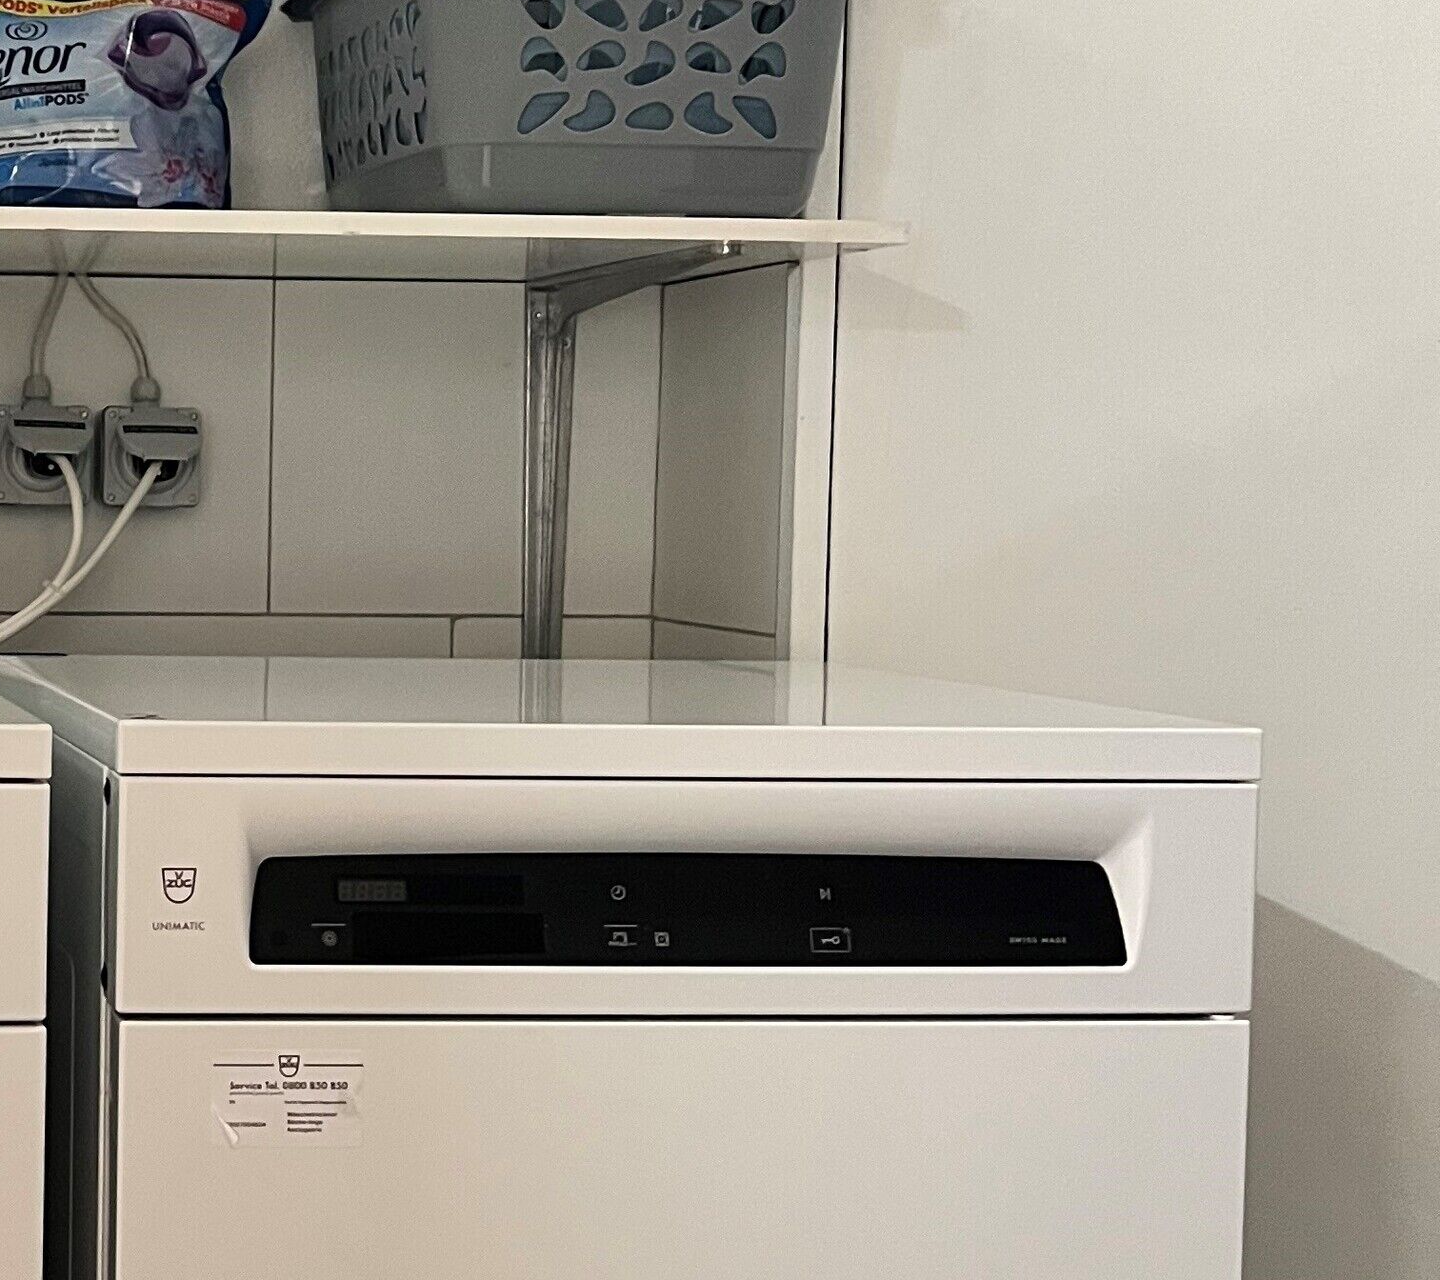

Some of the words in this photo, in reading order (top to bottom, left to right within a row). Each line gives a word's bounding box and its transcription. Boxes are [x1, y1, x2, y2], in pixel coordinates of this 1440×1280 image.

[152, 921, 205, 931] UNIMATIC
[229, 1081, 262, 1090] Service
[282, 1081, 307, 1090] 0800
